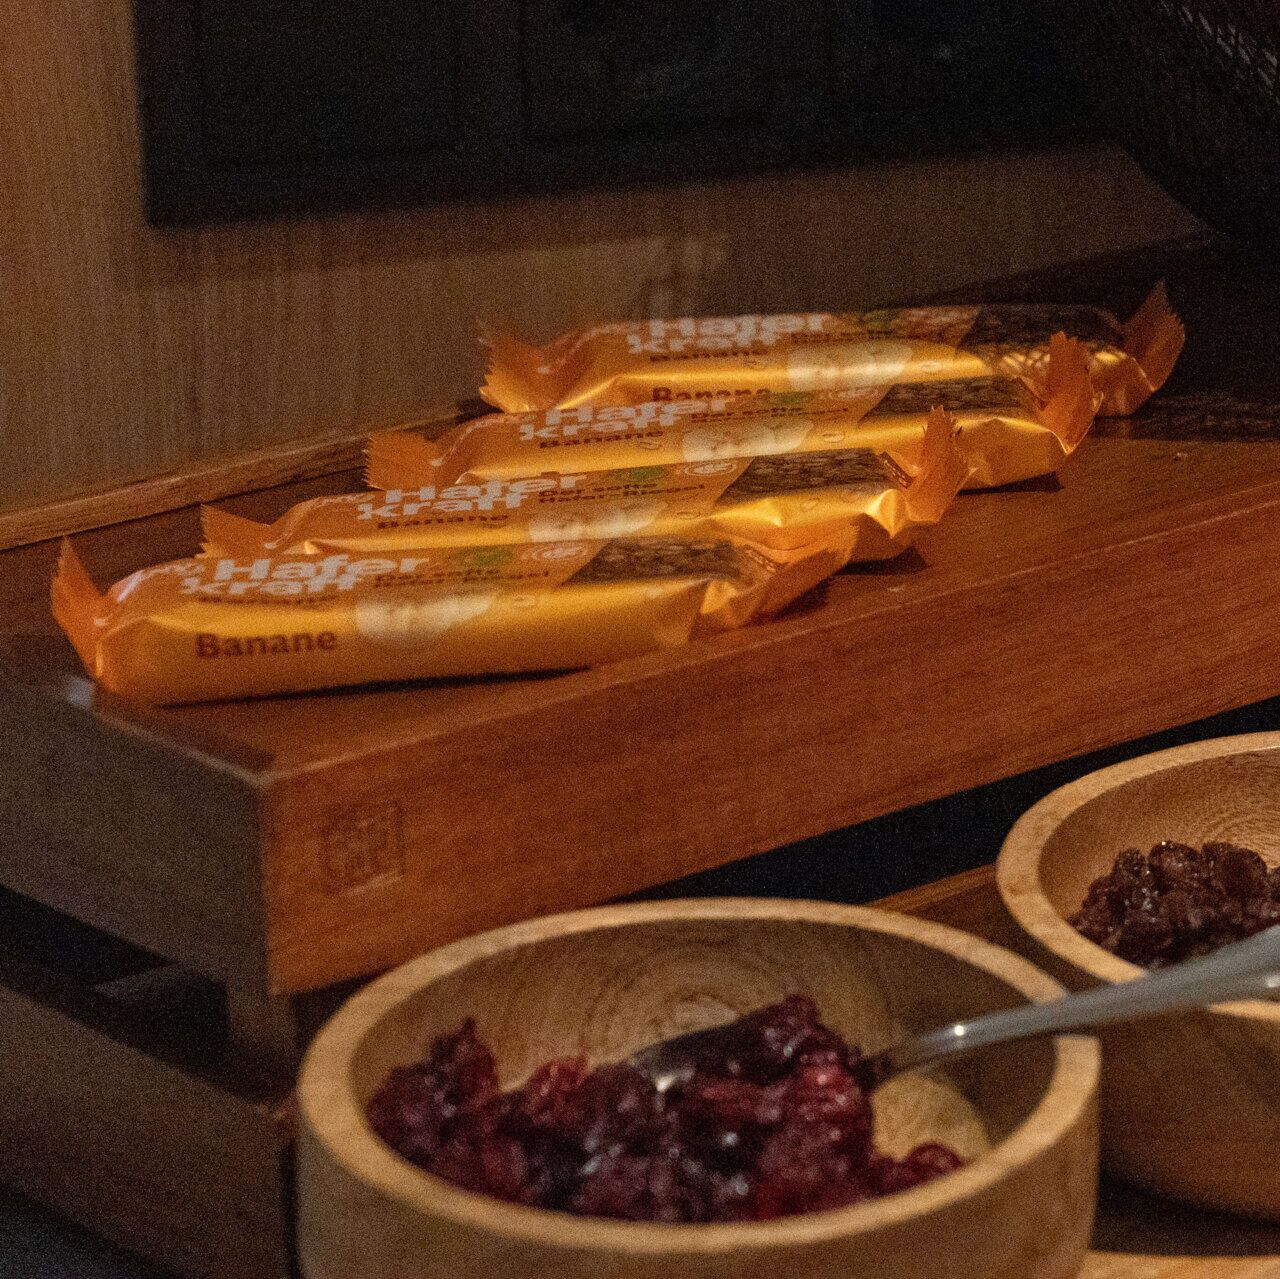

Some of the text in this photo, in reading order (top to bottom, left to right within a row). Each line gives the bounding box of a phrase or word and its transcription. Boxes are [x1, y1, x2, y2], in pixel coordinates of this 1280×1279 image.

[545, 398, 735, 425] Hafer
[385, 475, 588, 504] Hafer
[214, 554, 431, 581] Hafer
[195, 631, 338, 658] Banane
